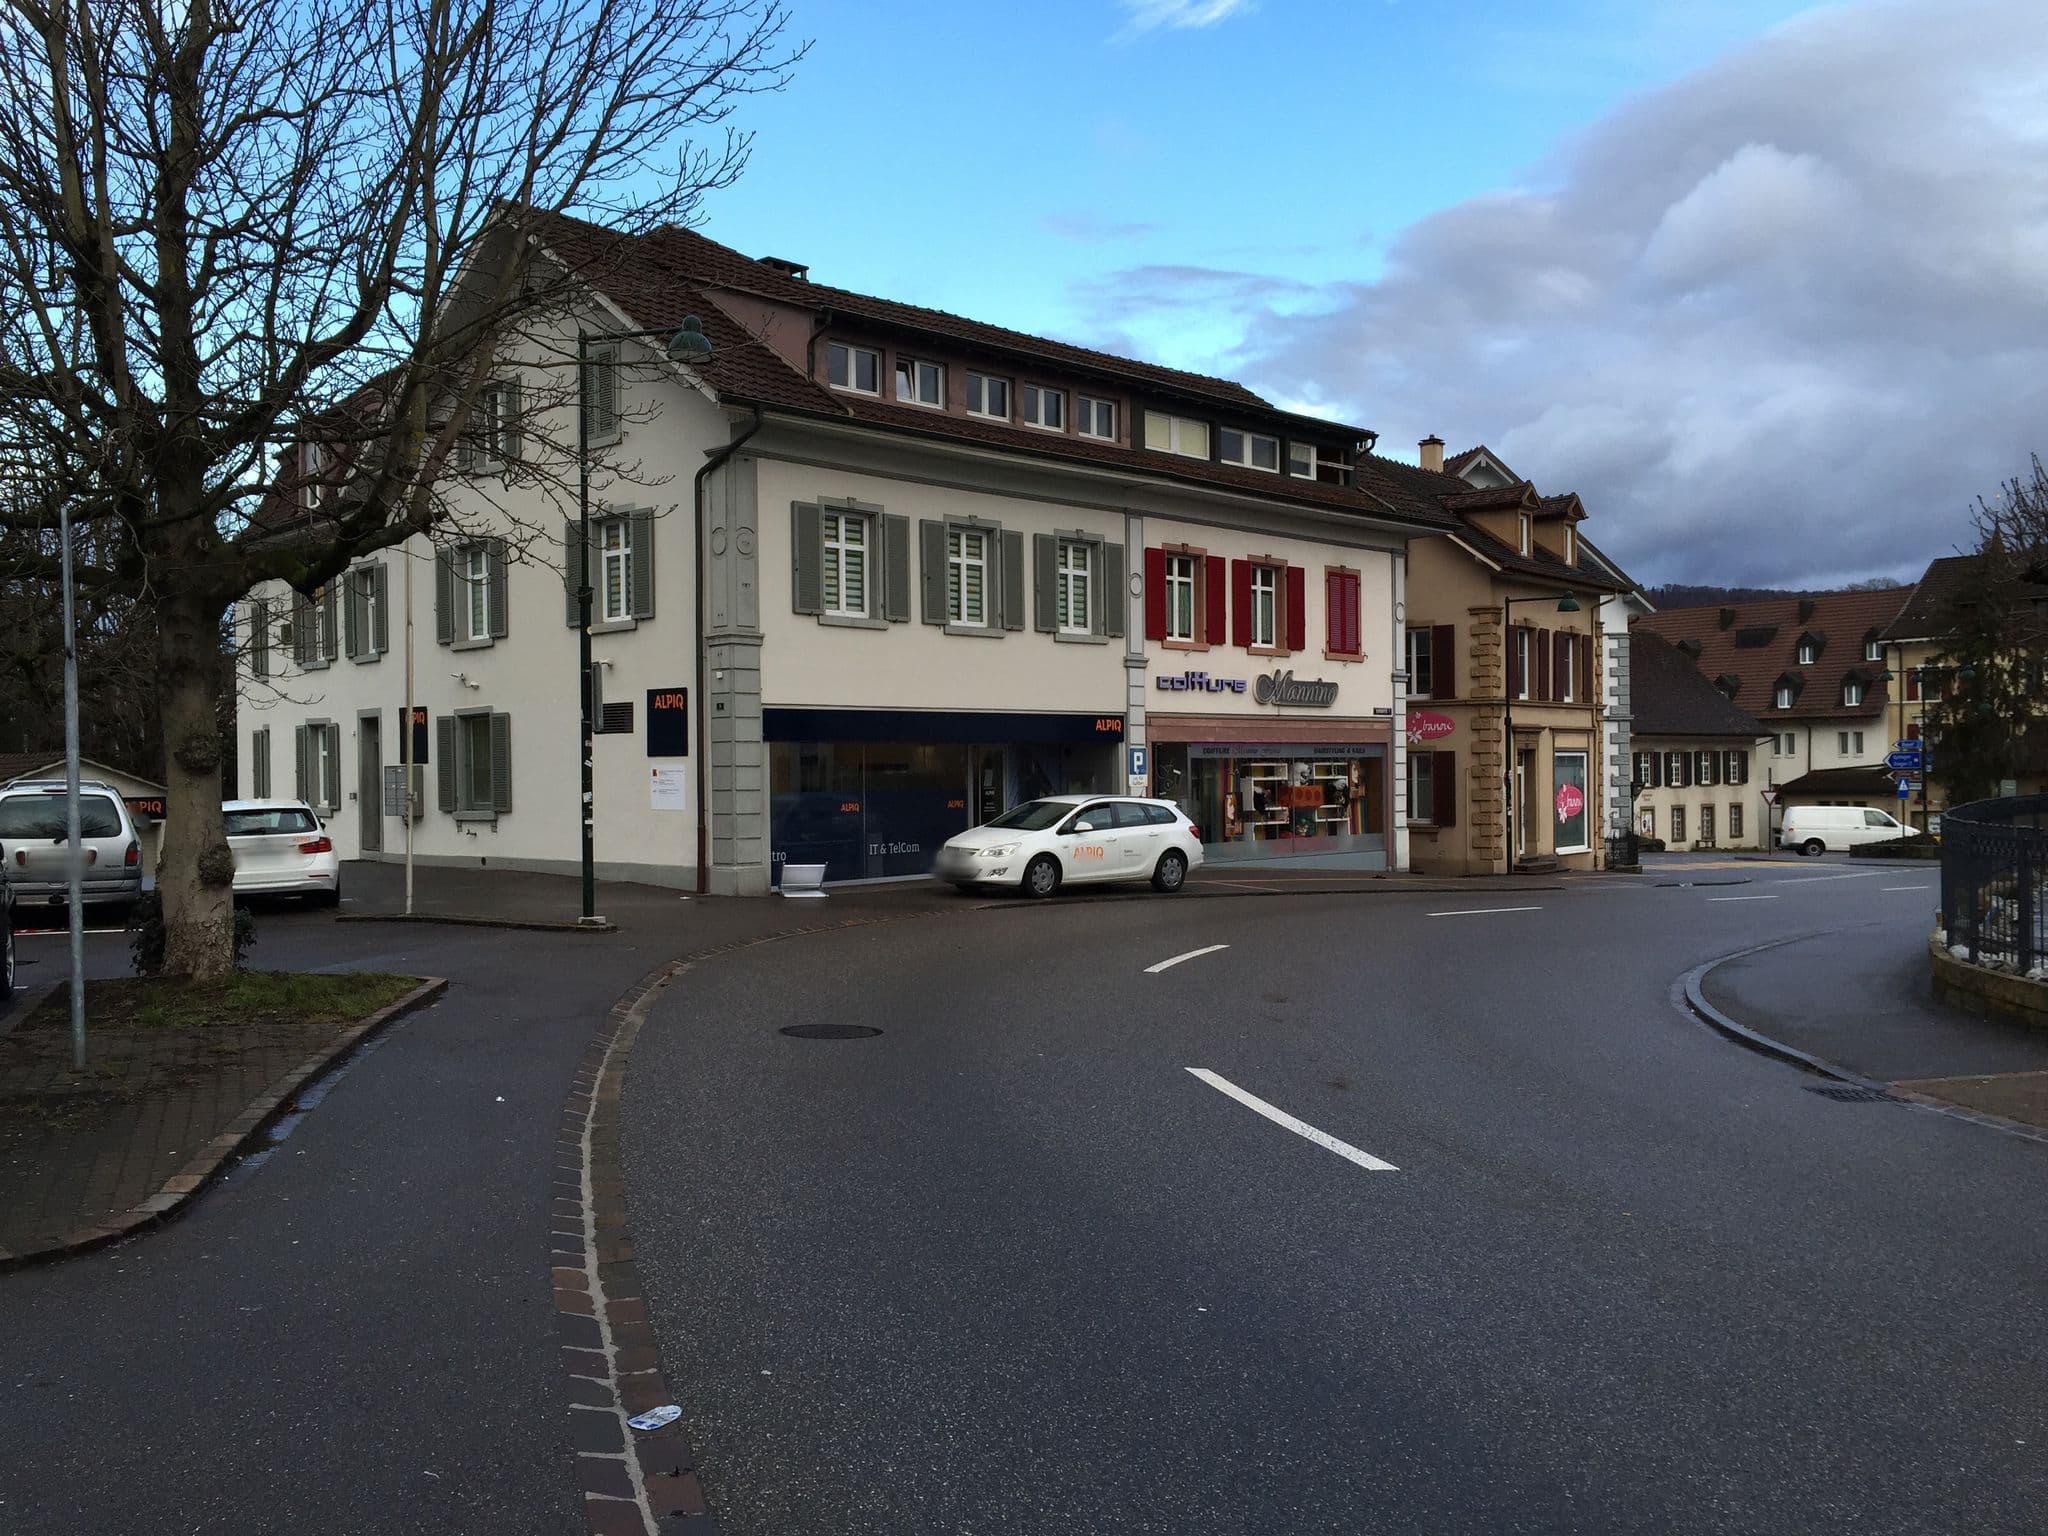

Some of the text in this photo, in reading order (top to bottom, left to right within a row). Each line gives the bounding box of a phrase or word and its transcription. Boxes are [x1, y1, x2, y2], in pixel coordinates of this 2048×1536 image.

[1156, 671, 1247, 693] coiffure
[654, 694, 684, 710] ALPIQ
[1096, 719, 1122, 733] ALPIQ
[840, 803, 860, 814] ALPIQ
[947, 799, 964, 809] ALPIQ
[869, 842, 920, 855] IT & TelCom
